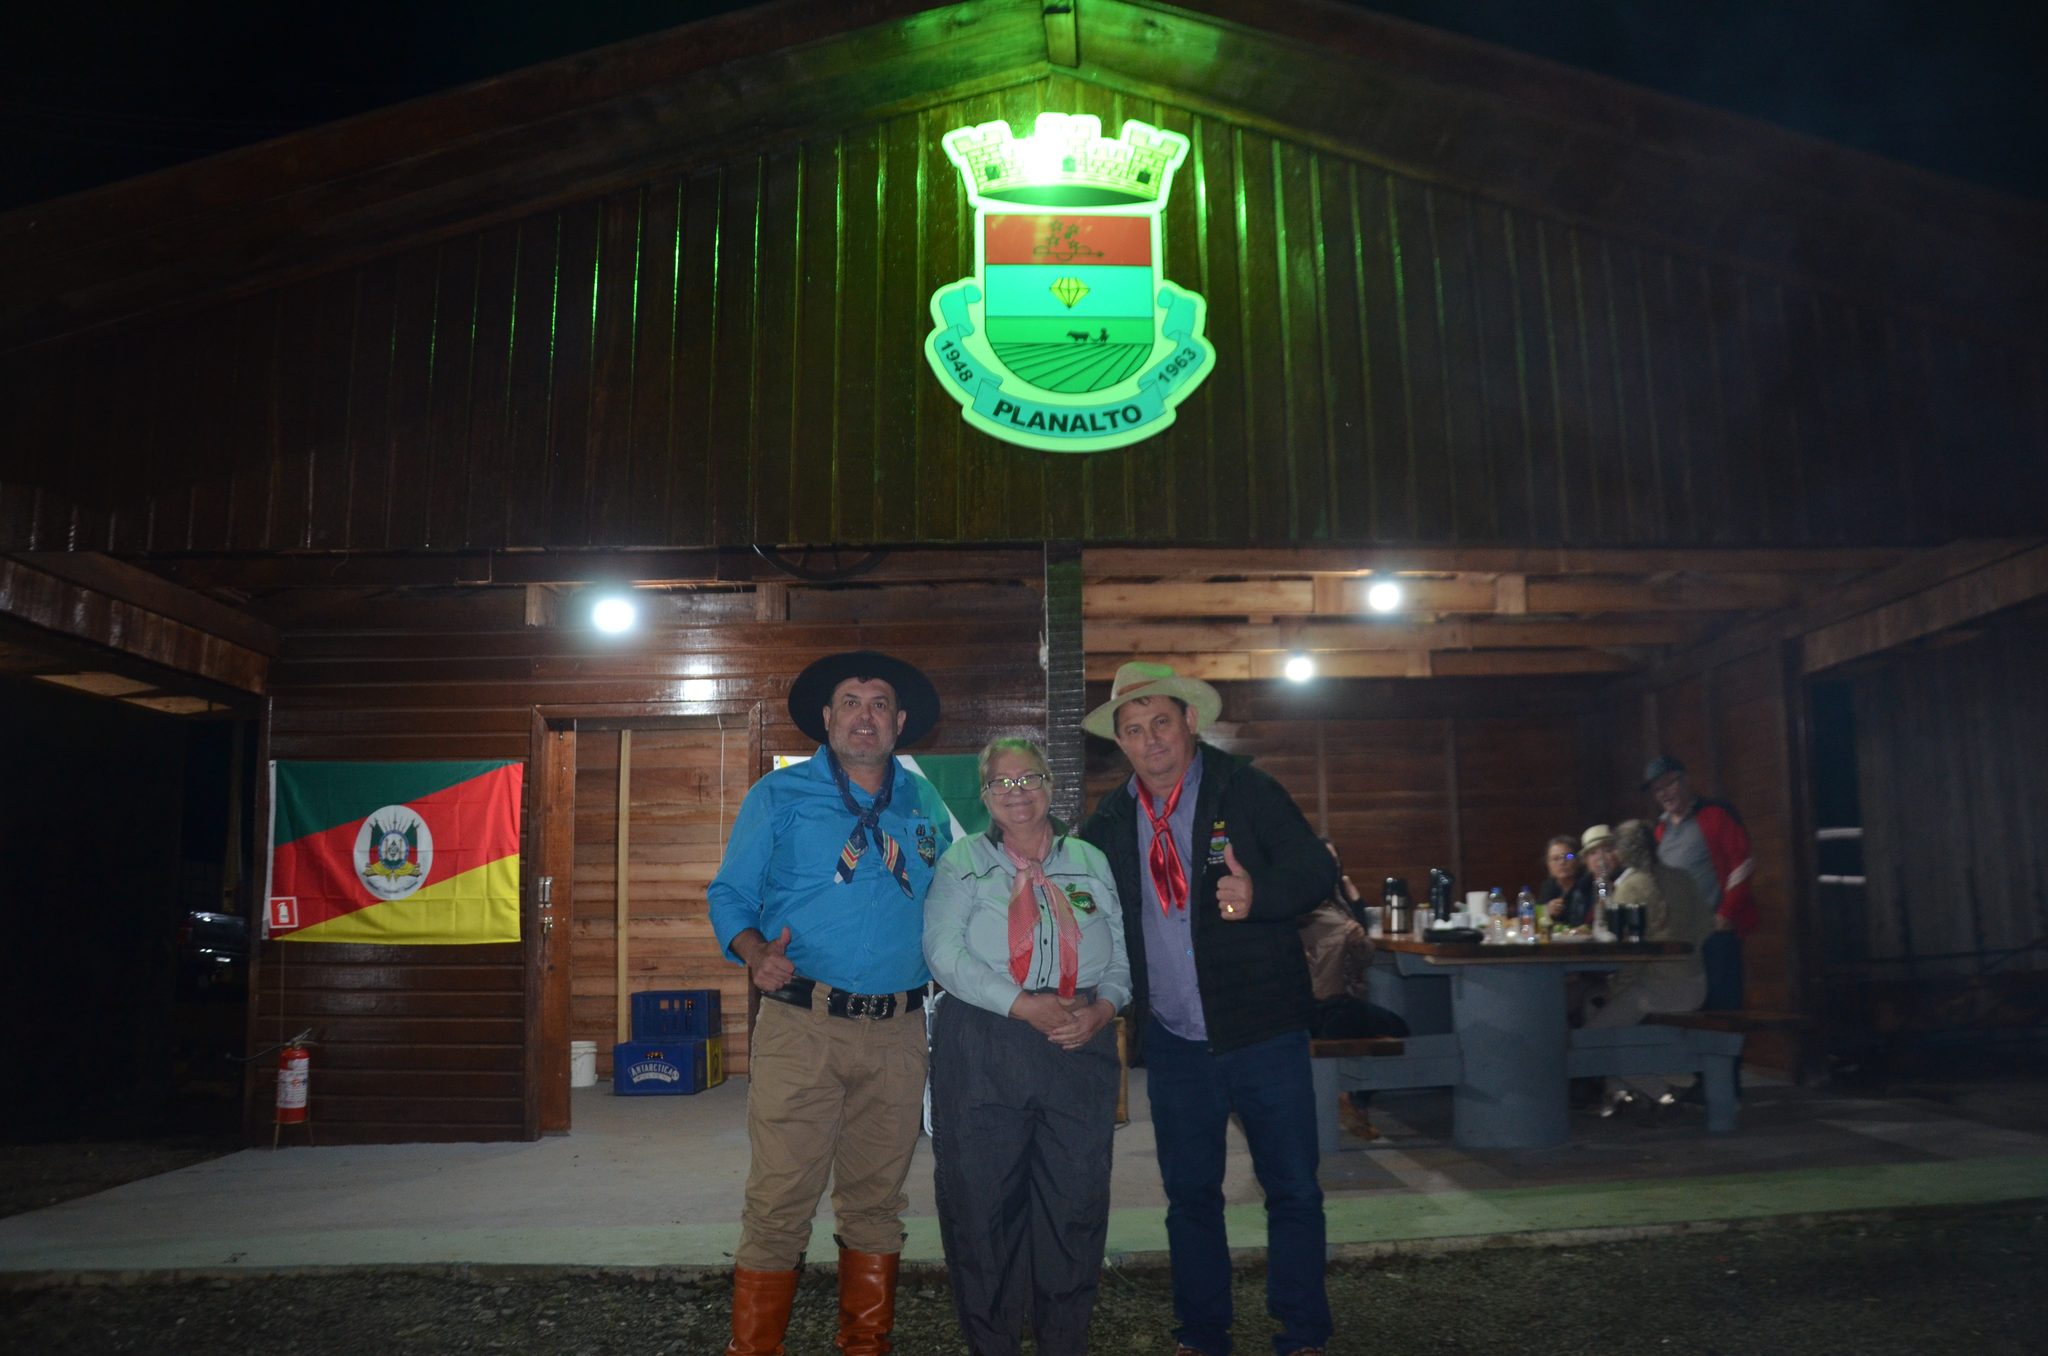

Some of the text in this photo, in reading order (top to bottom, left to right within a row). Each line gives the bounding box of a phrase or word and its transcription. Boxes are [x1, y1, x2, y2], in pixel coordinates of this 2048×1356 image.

[939, 340, 973, 383] 1948
[1158, 347, 1197, 385] 1963
[993, 399, 1143, 432] PLANALTO
[631, 1063, 673, 1077] ANTARCTICA
